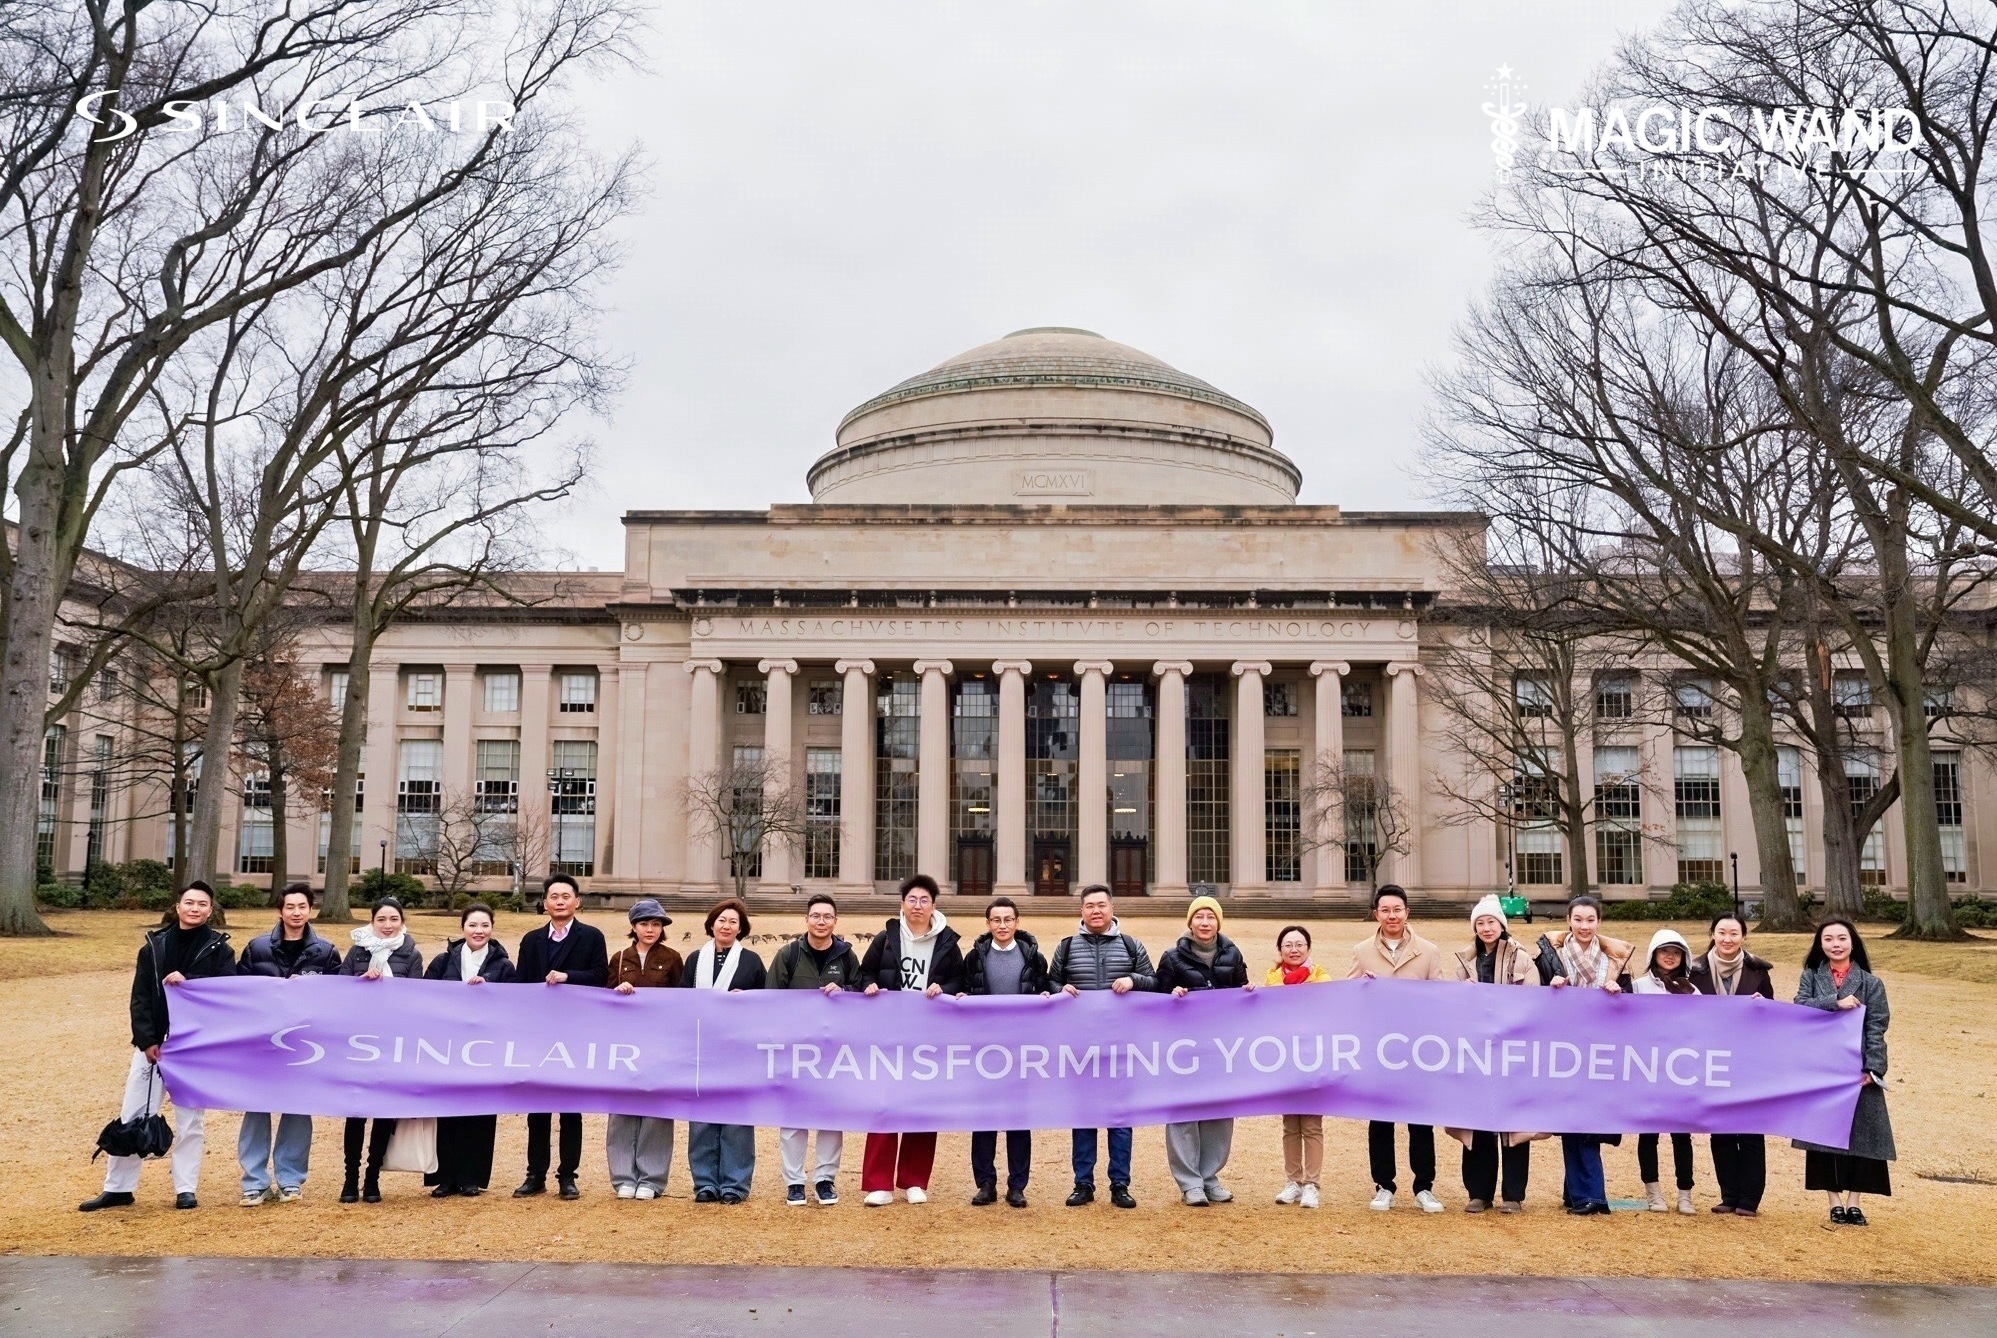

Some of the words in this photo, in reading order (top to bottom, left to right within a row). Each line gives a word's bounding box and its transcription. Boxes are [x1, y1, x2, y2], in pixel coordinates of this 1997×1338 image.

[1022, 474, 1084, 489] MCMXVI
[739, 620, 963, 637] MASSACHVSETTS
[987, 620, 1124, 638] INSTITVTE
[1145, 621, 1174, 638] OF
[1194, 621, 1371, 639] TECHNOLOGY
[346, 1034, 642, 1072] SINCLAIR
[757, 1038, 1200, 1081] TRANSFORMING
[1212, 1034, 1361, 1074] YOUR
[1376, 1032, 1733, 1088] CONFIDENCE
